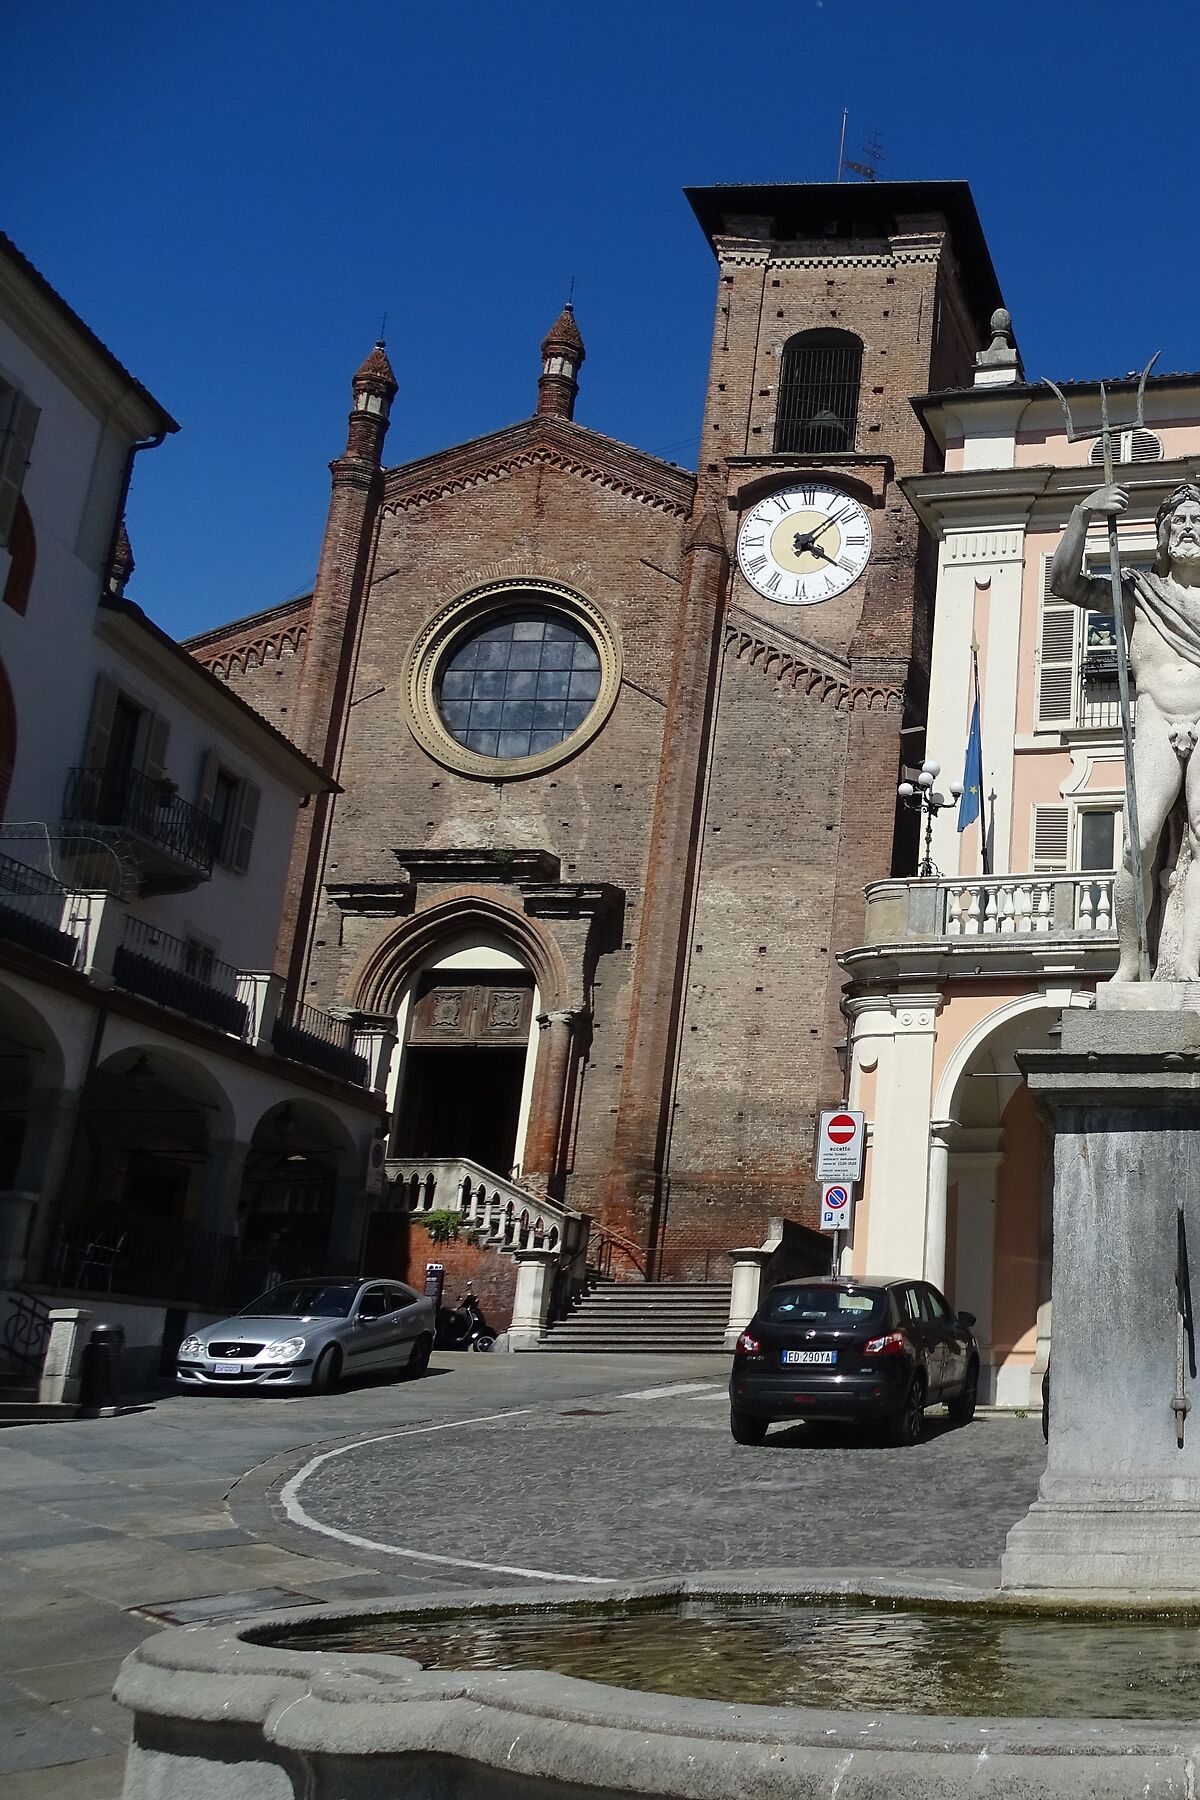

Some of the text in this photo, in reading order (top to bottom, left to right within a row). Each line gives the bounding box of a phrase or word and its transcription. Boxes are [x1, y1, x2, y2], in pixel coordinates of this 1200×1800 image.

[801, 489, 816, 506] XII
[772, 495, 792, 515] XI
[754, 514, 773, 526] X
[846, 535, 866, 546] III
[803, 1352, 831, 1362] 290YA
